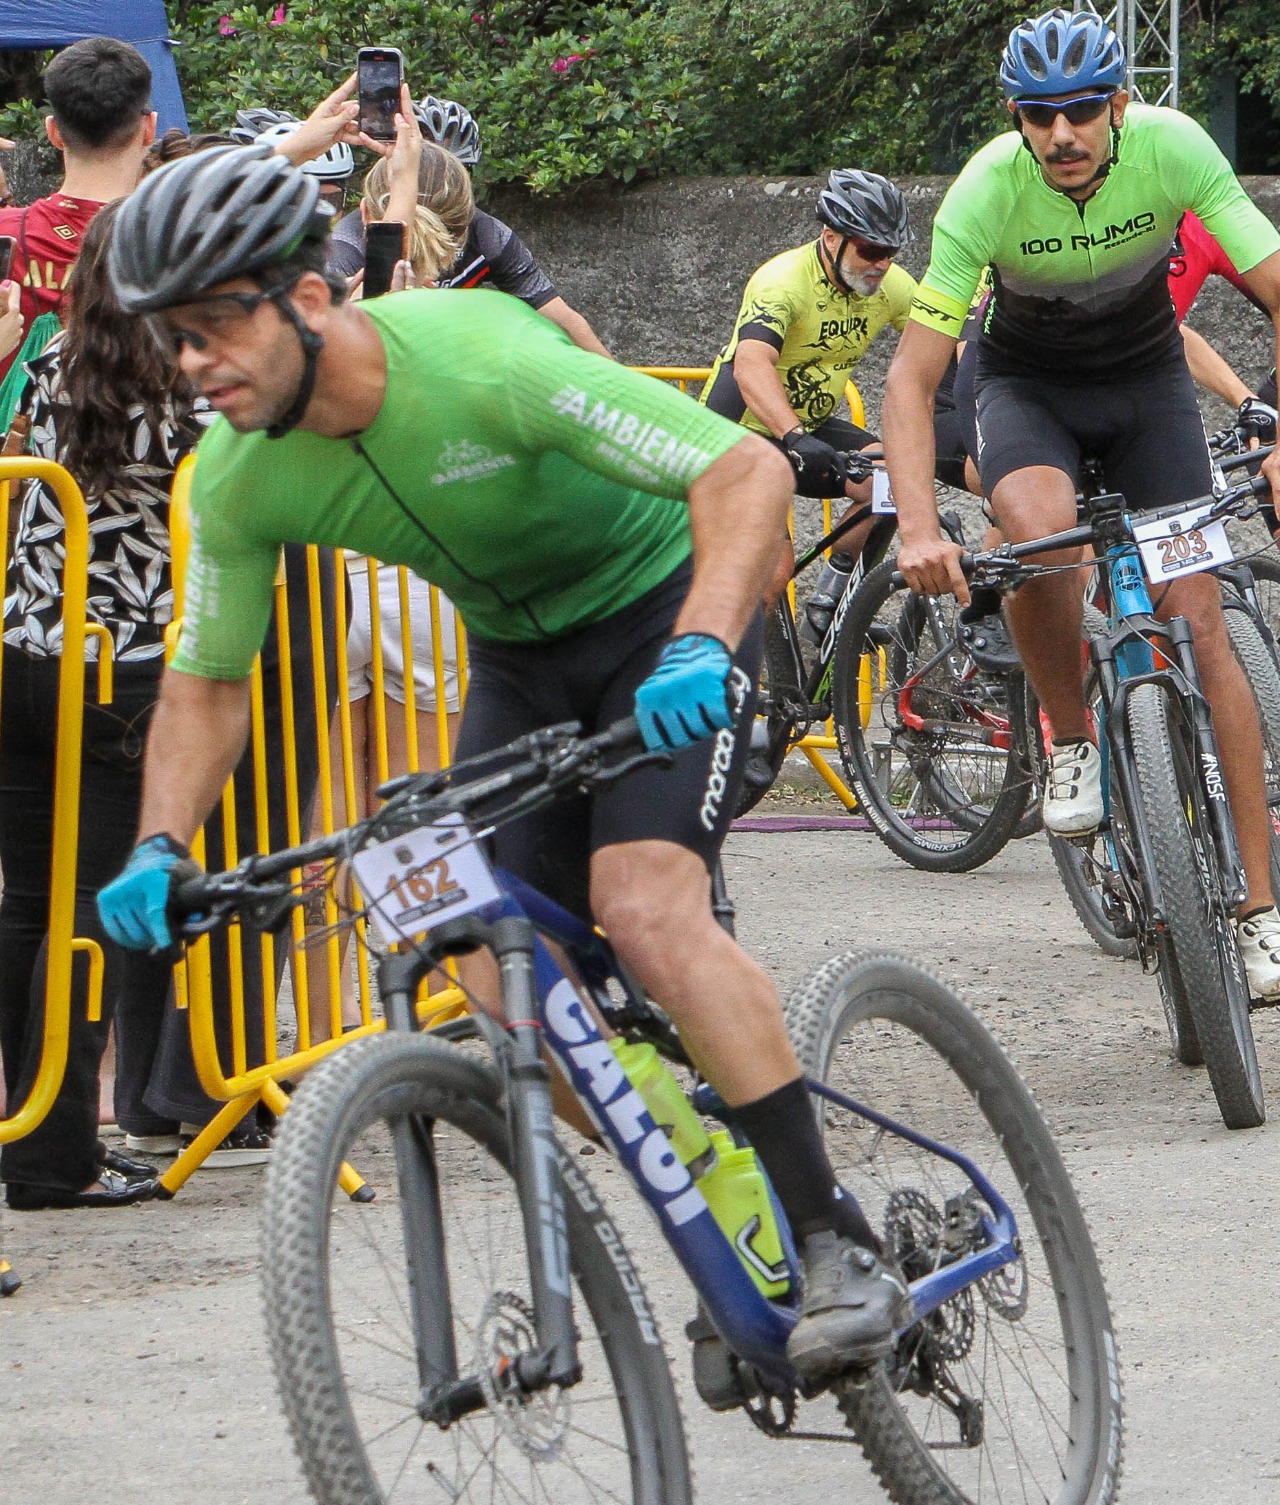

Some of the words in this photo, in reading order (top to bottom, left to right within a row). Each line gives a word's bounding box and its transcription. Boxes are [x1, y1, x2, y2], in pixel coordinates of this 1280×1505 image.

[1019, 237, 1063, 256] 100
[1070, 211, 1156, 251] RUMO
[818, 315, 868, 341] EQUIPE
[1156, 530, 1208, 565] 203
[1200, 752, 1226, 802] #NOSF
[912, 834, 970, 853] ALEXRIMS
[386, 857, 459, 908] 162
[545, 976, 709, 1227] CALOI
